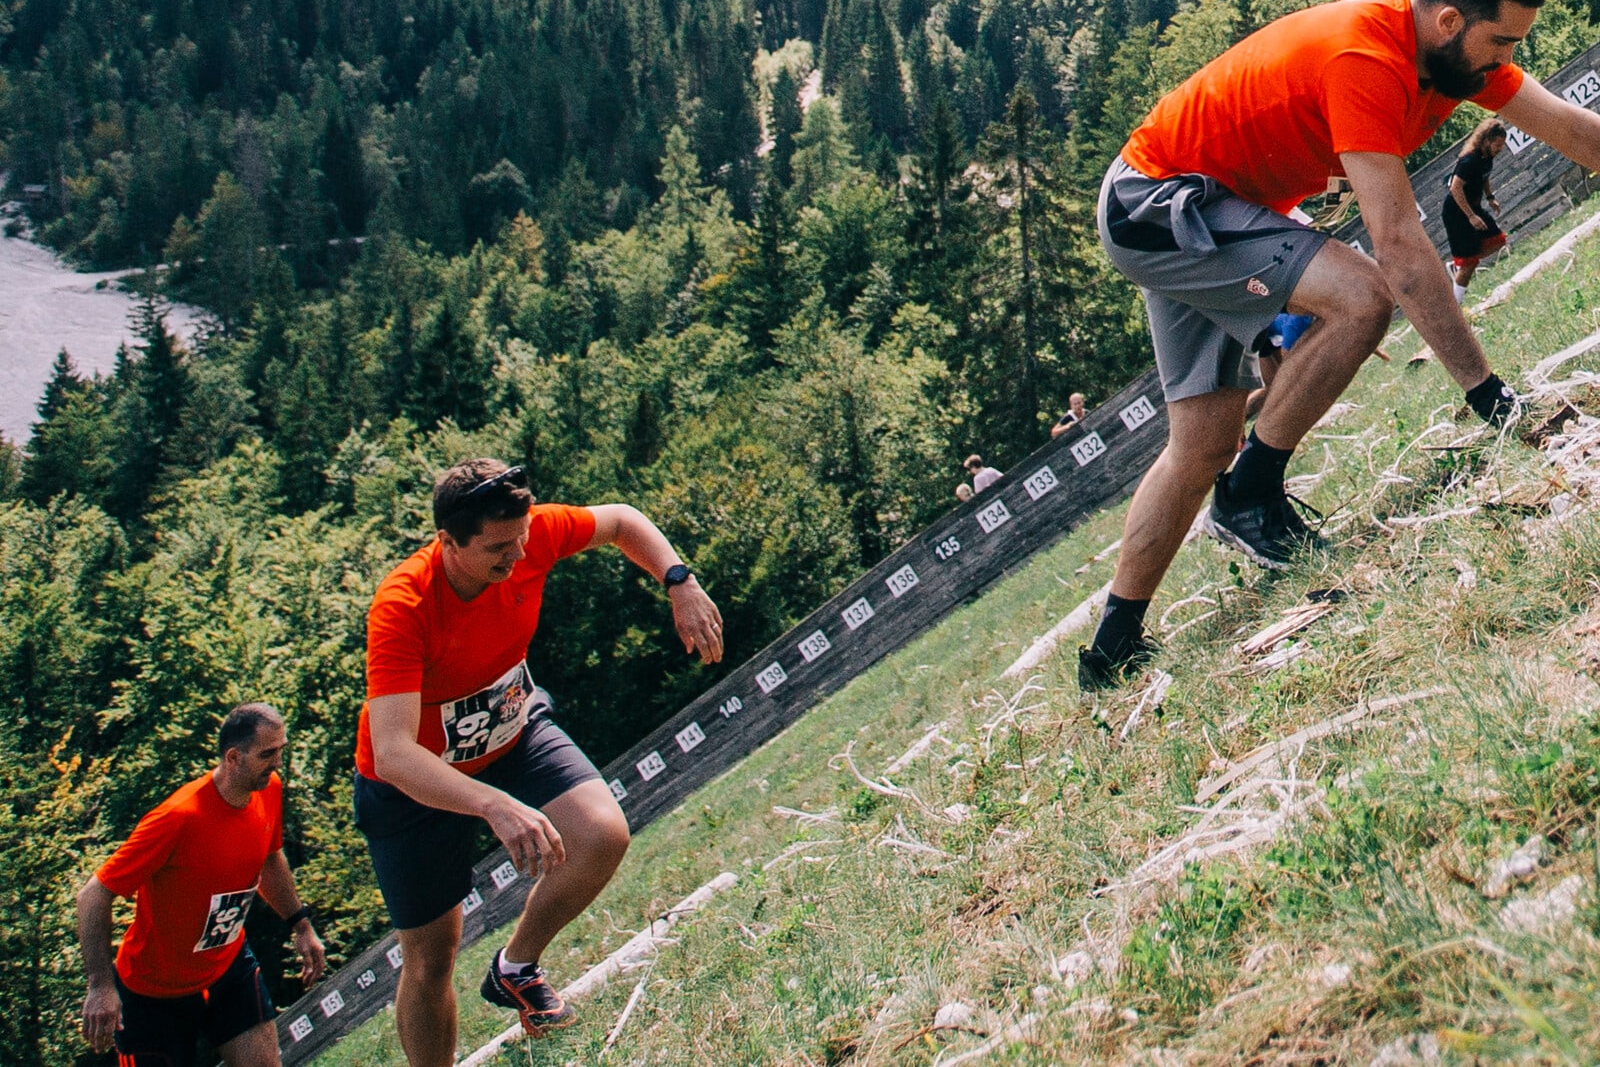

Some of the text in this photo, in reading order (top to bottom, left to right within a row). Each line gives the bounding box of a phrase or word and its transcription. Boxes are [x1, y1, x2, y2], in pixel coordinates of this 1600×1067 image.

[1569, 76, 1600, 107] 123
[1126, 400, 1152, 425] 131
[1076, 436, 1103, 461] 132
[1029, 471, 1054, 495] 133
[982, 504, 1006, 528] 134
[935, 536, 961, 560] 135
[891, 569, 915, 592] 136
[845, 600, 869, 624] 137
[802, 634, 826, 659] 138
[760, 666, 782, 688] 139
[719, 696, 743, 718] 140
[680, 726, 700, 746] 141
[640, 755, 662, 777] 142
[357, 969, 376, 990] 150
